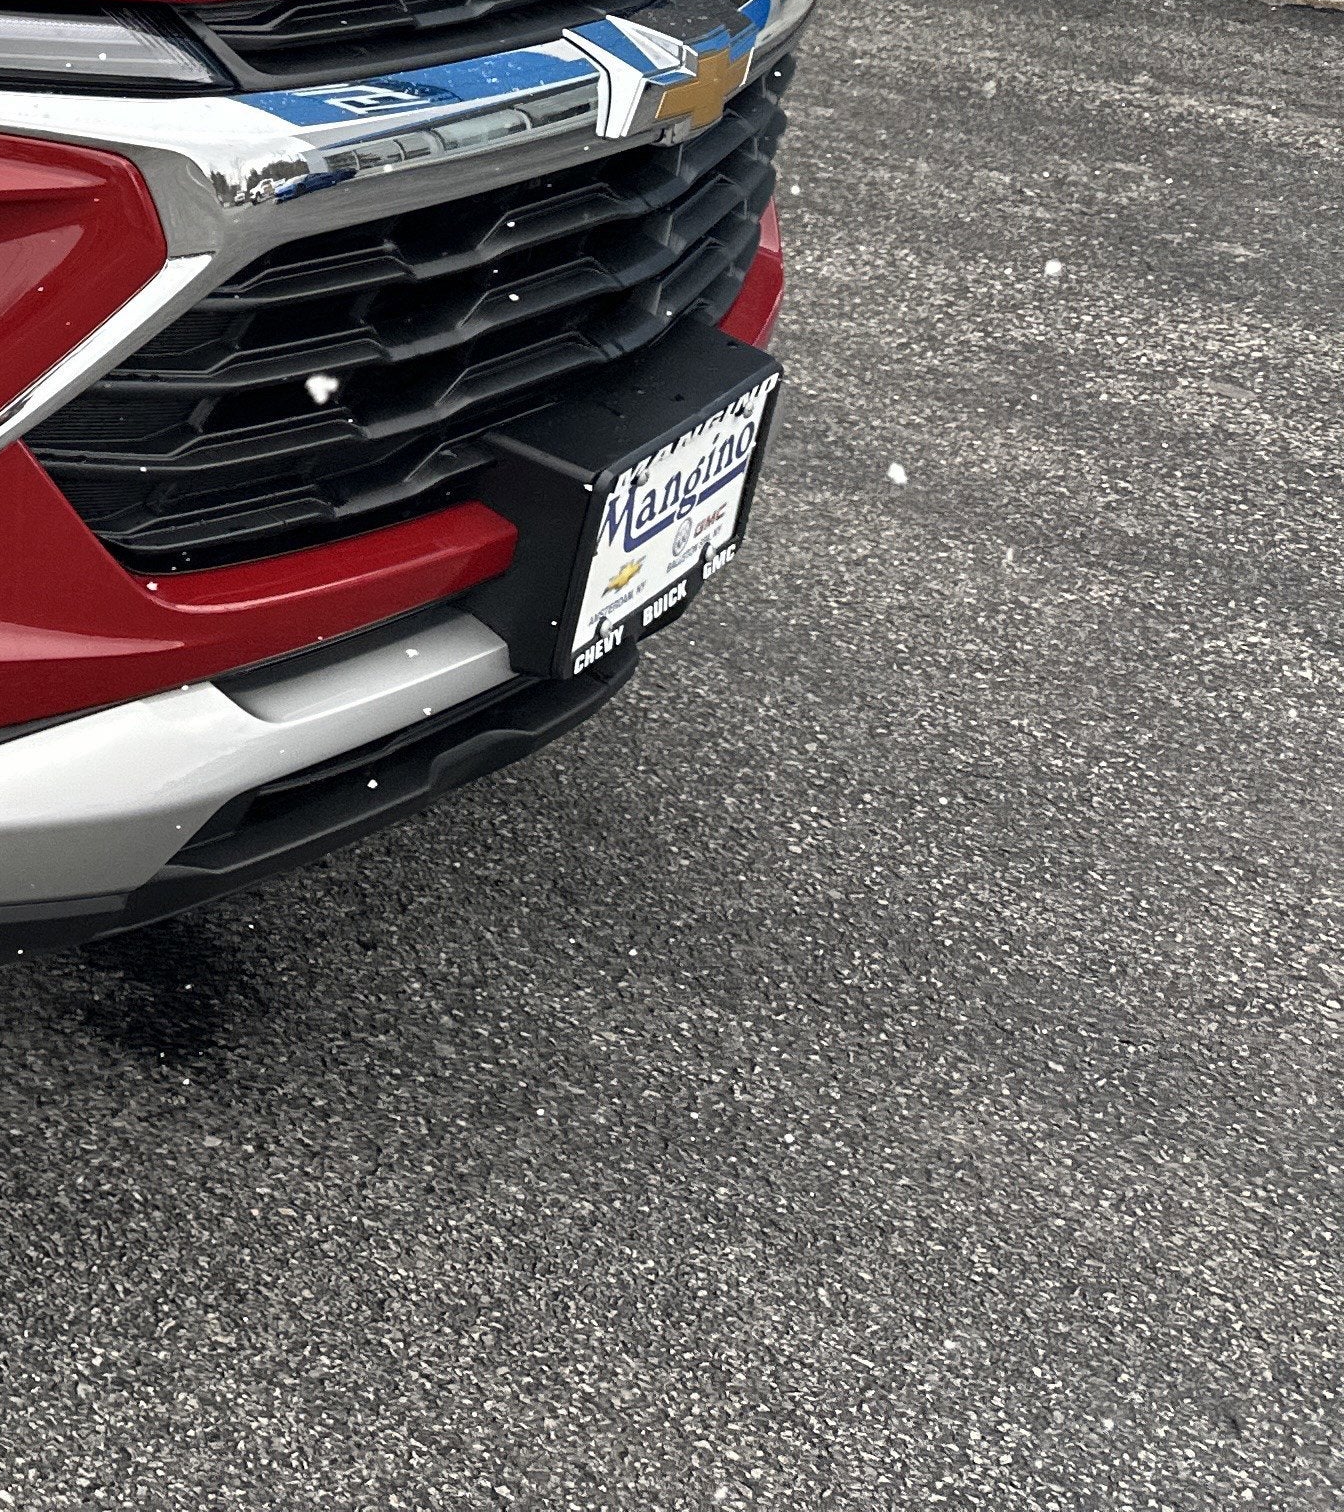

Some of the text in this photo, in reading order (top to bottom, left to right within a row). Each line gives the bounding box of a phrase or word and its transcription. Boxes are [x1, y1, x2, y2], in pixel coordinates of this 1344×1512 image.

[596, 421, 756, 553] Mangino
[573, 543, 737, 675] CHEVY BUICK GMC
